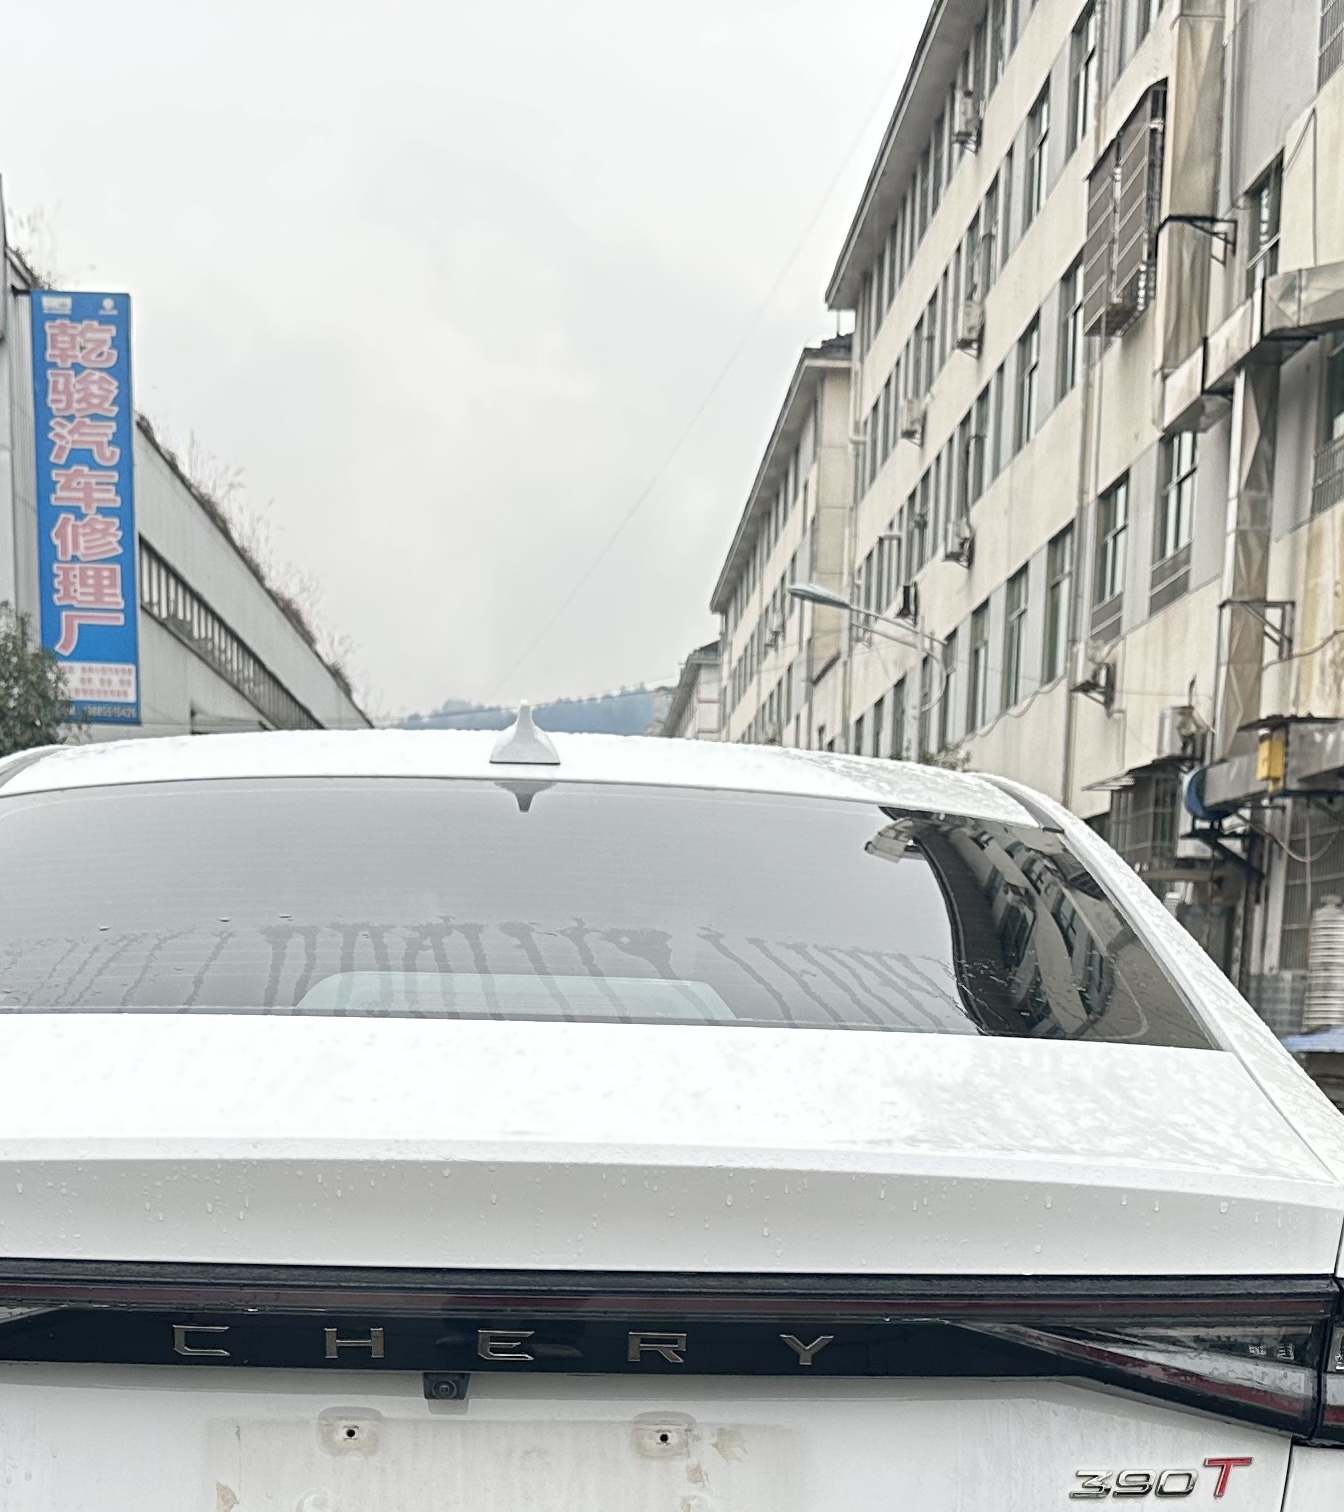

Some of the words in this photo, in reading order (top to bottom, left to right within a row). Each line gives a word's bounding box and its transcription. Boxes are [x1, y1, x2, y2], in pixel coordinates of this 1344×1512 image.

[44, 319, 124, 656] 乾骏汽车修理厂
[172, 1323, 835, 1366] CHERY
